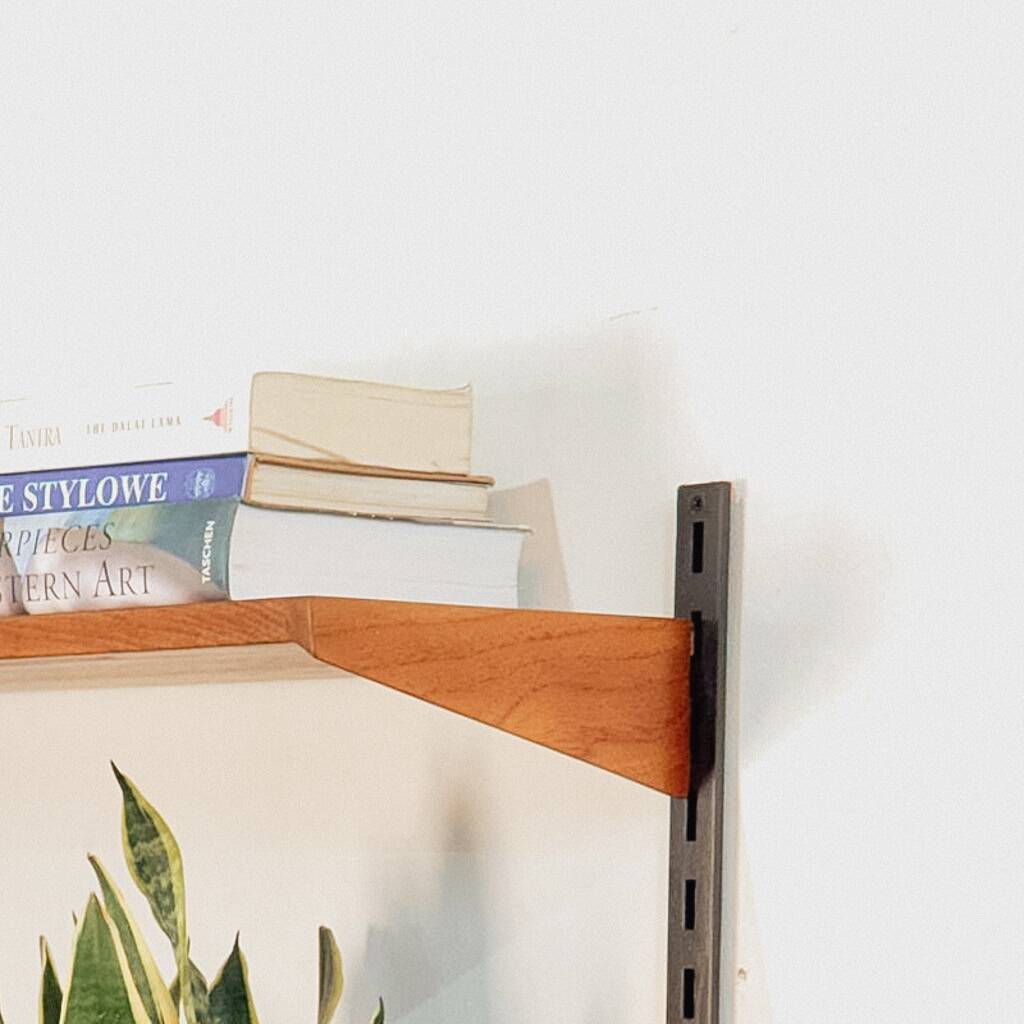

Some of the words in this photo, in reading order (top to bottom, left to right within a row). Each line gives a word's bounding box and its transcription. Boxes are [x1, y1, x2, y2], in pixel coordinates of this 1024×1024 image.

[6, 423, 64, 451] TANTRA
[86, 422, 106, 435] THE
[111, 419, 146, 434] DALAI
[151, 416, 183, 430] LAMA
[22, 471, 168, 513] STYLOWE
[201, 520, 215, 584] TASCHEN
[93, 559, 155, 599] ART
